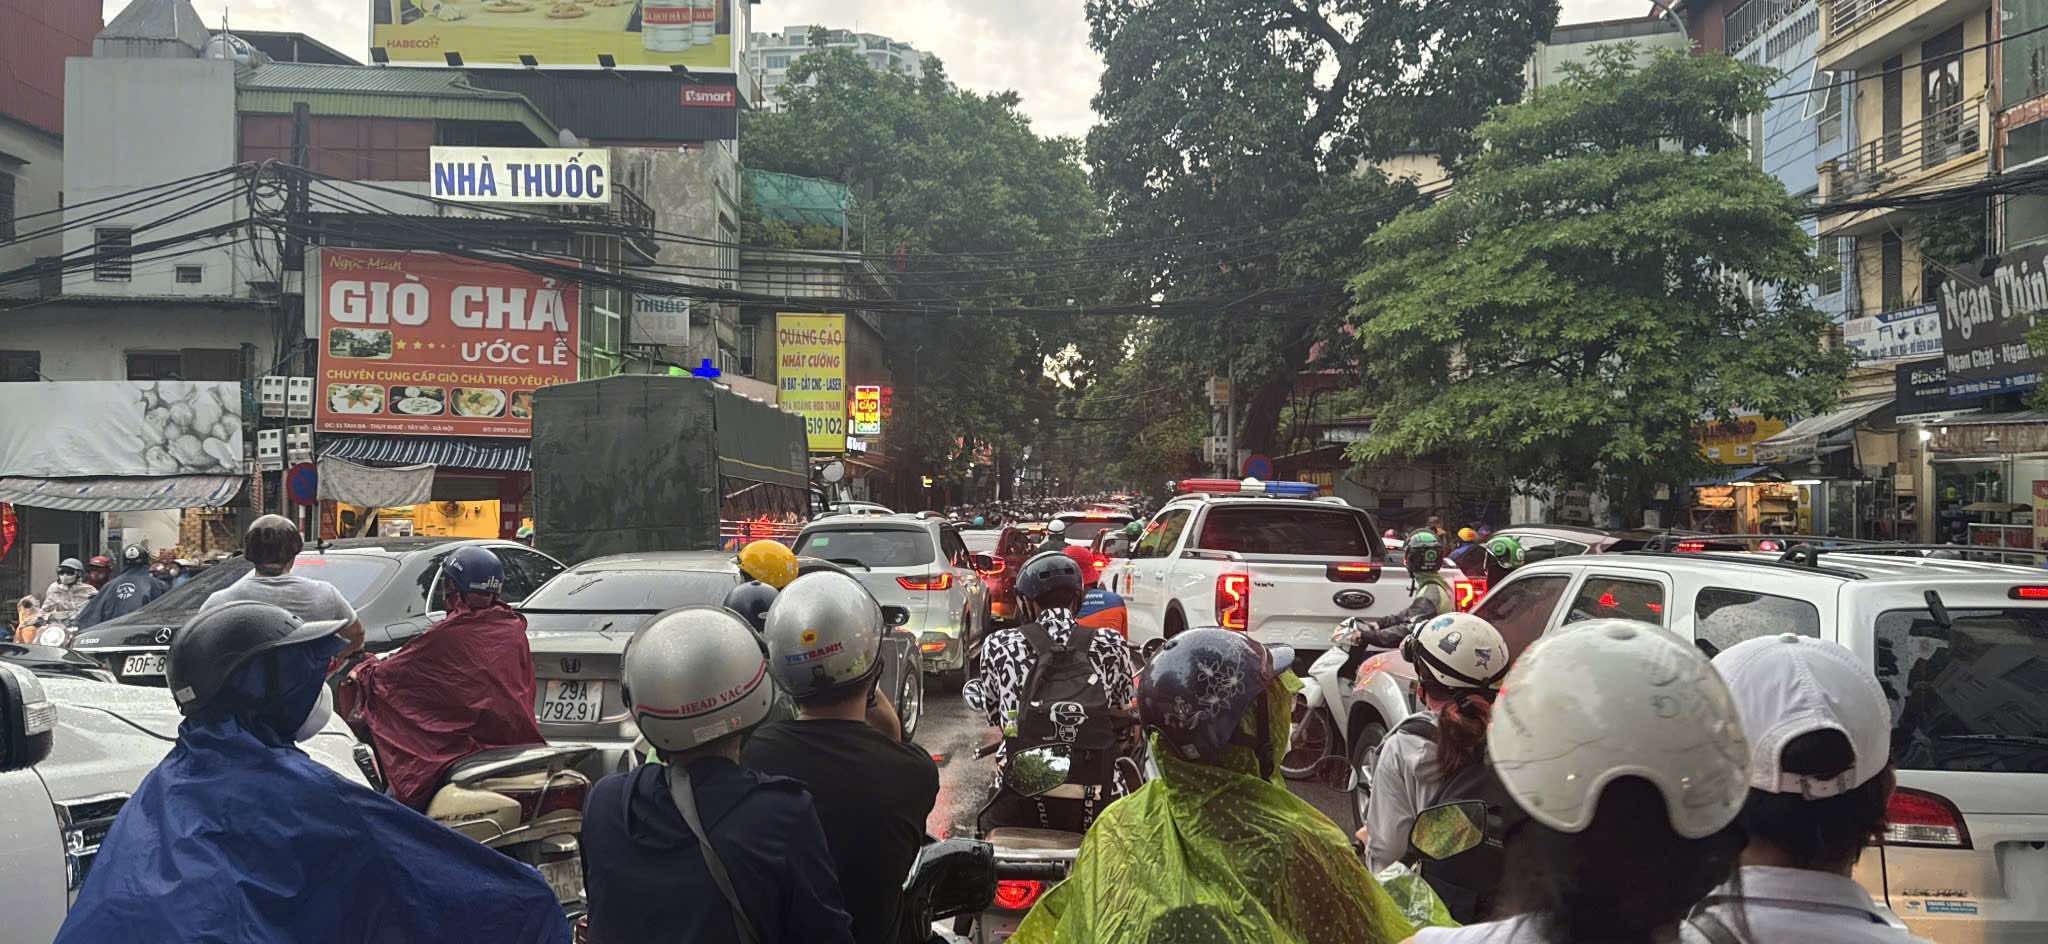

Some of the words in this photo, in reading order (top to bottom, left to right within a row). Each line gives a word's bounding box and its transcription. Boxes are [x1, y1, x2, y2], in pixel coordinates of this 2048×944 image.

[387, 39, 430, 49] HABECO
[434, 154, 498, 196] NHÀ
[506, 152, 604, 199] THUỐC
[329, 273, 430, 326] GIÒ
[450, 276, 569, 332] CHẢ
[1941, 279, 1995, 339] Ngan
[780, 321, 816, 346] QUẢNG
[819, 323, 842, 345] CÁO
[461, 338, 530, 364] ƯỚC
[537, 337, 569, 366] LỄ
[1947, 353, 1971, 373] Ngan
[2001, 343, 2030, 363] Ngan
[326, 368, 375, 380] CHUYÊN
[376, 371, 411, 381] CUNG
[412, 370, 436, 382] CẤP
[437, 372, 459, 383] GIÒ
[461, 373, 486, 384] CHẢ
[487, 375, 520, 385] THEO
[520, 374, 542, 386] YÊU
[808, 418, 823, 434] 519
[825, 418, 842, 434] 102
[558, 681, 588, 700] 29A
[680, 697, 718, 714] HEAD
[719, 685, 742, 702] VAC
[543, 701, 597, 720] 792.91
